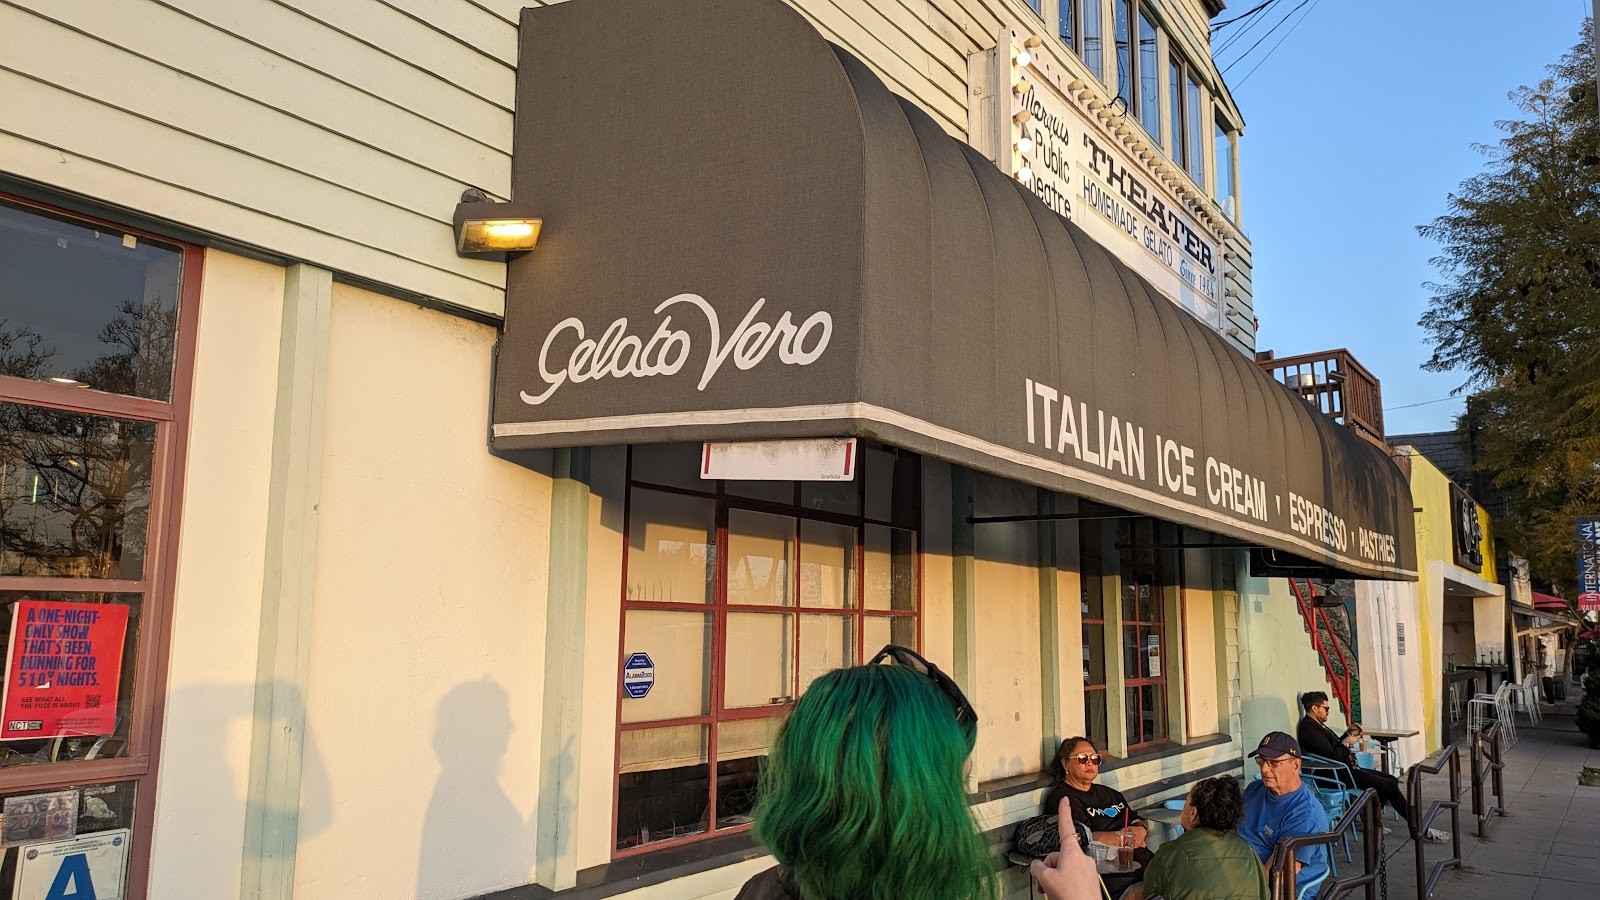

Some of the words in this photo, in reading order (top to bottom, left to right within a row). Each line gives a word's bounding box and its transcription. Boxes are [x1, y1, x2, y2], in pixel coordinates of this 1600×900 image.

[1020, 77, 1069, 146] Marquis
[1035, 127, 1070, 184] Public
[1083, 132, 1215, 275] THEATER
[1083, 175, 1138, 240] HOMEMADE
[1143, 225, 1173, 267] GELATO
[1180, 258, 1197, 286] Since
[519, 315, 691, 405] Gelato
[653, 293, 833, 391] Vero
[1026, 378, 1145, 481] ITALIAN
[1156, 434, 1196, 497] ICE
[1206, 456, 1268, 522] CREAM
[1289, 492, 1347, 553] ESPRESSO
[1359, 526, 1396, 564] PASTRIES
[25, 624, 54, 639] ONLY
[57, 624, 89, 639] SHOW
[27, 608, 35, 622] A
[38, 608, 100, 624] ONE-NIGHT-
[20, 656, 73, 670] RUNNING
[75, 656, 96, 670] FOR
[23, 640, 62, 654] THAT'S
[64, 640, 92, 654] BEEN
[57, 672, 99, 686] NIGHTS.
[45, 853, 97, 900] A
